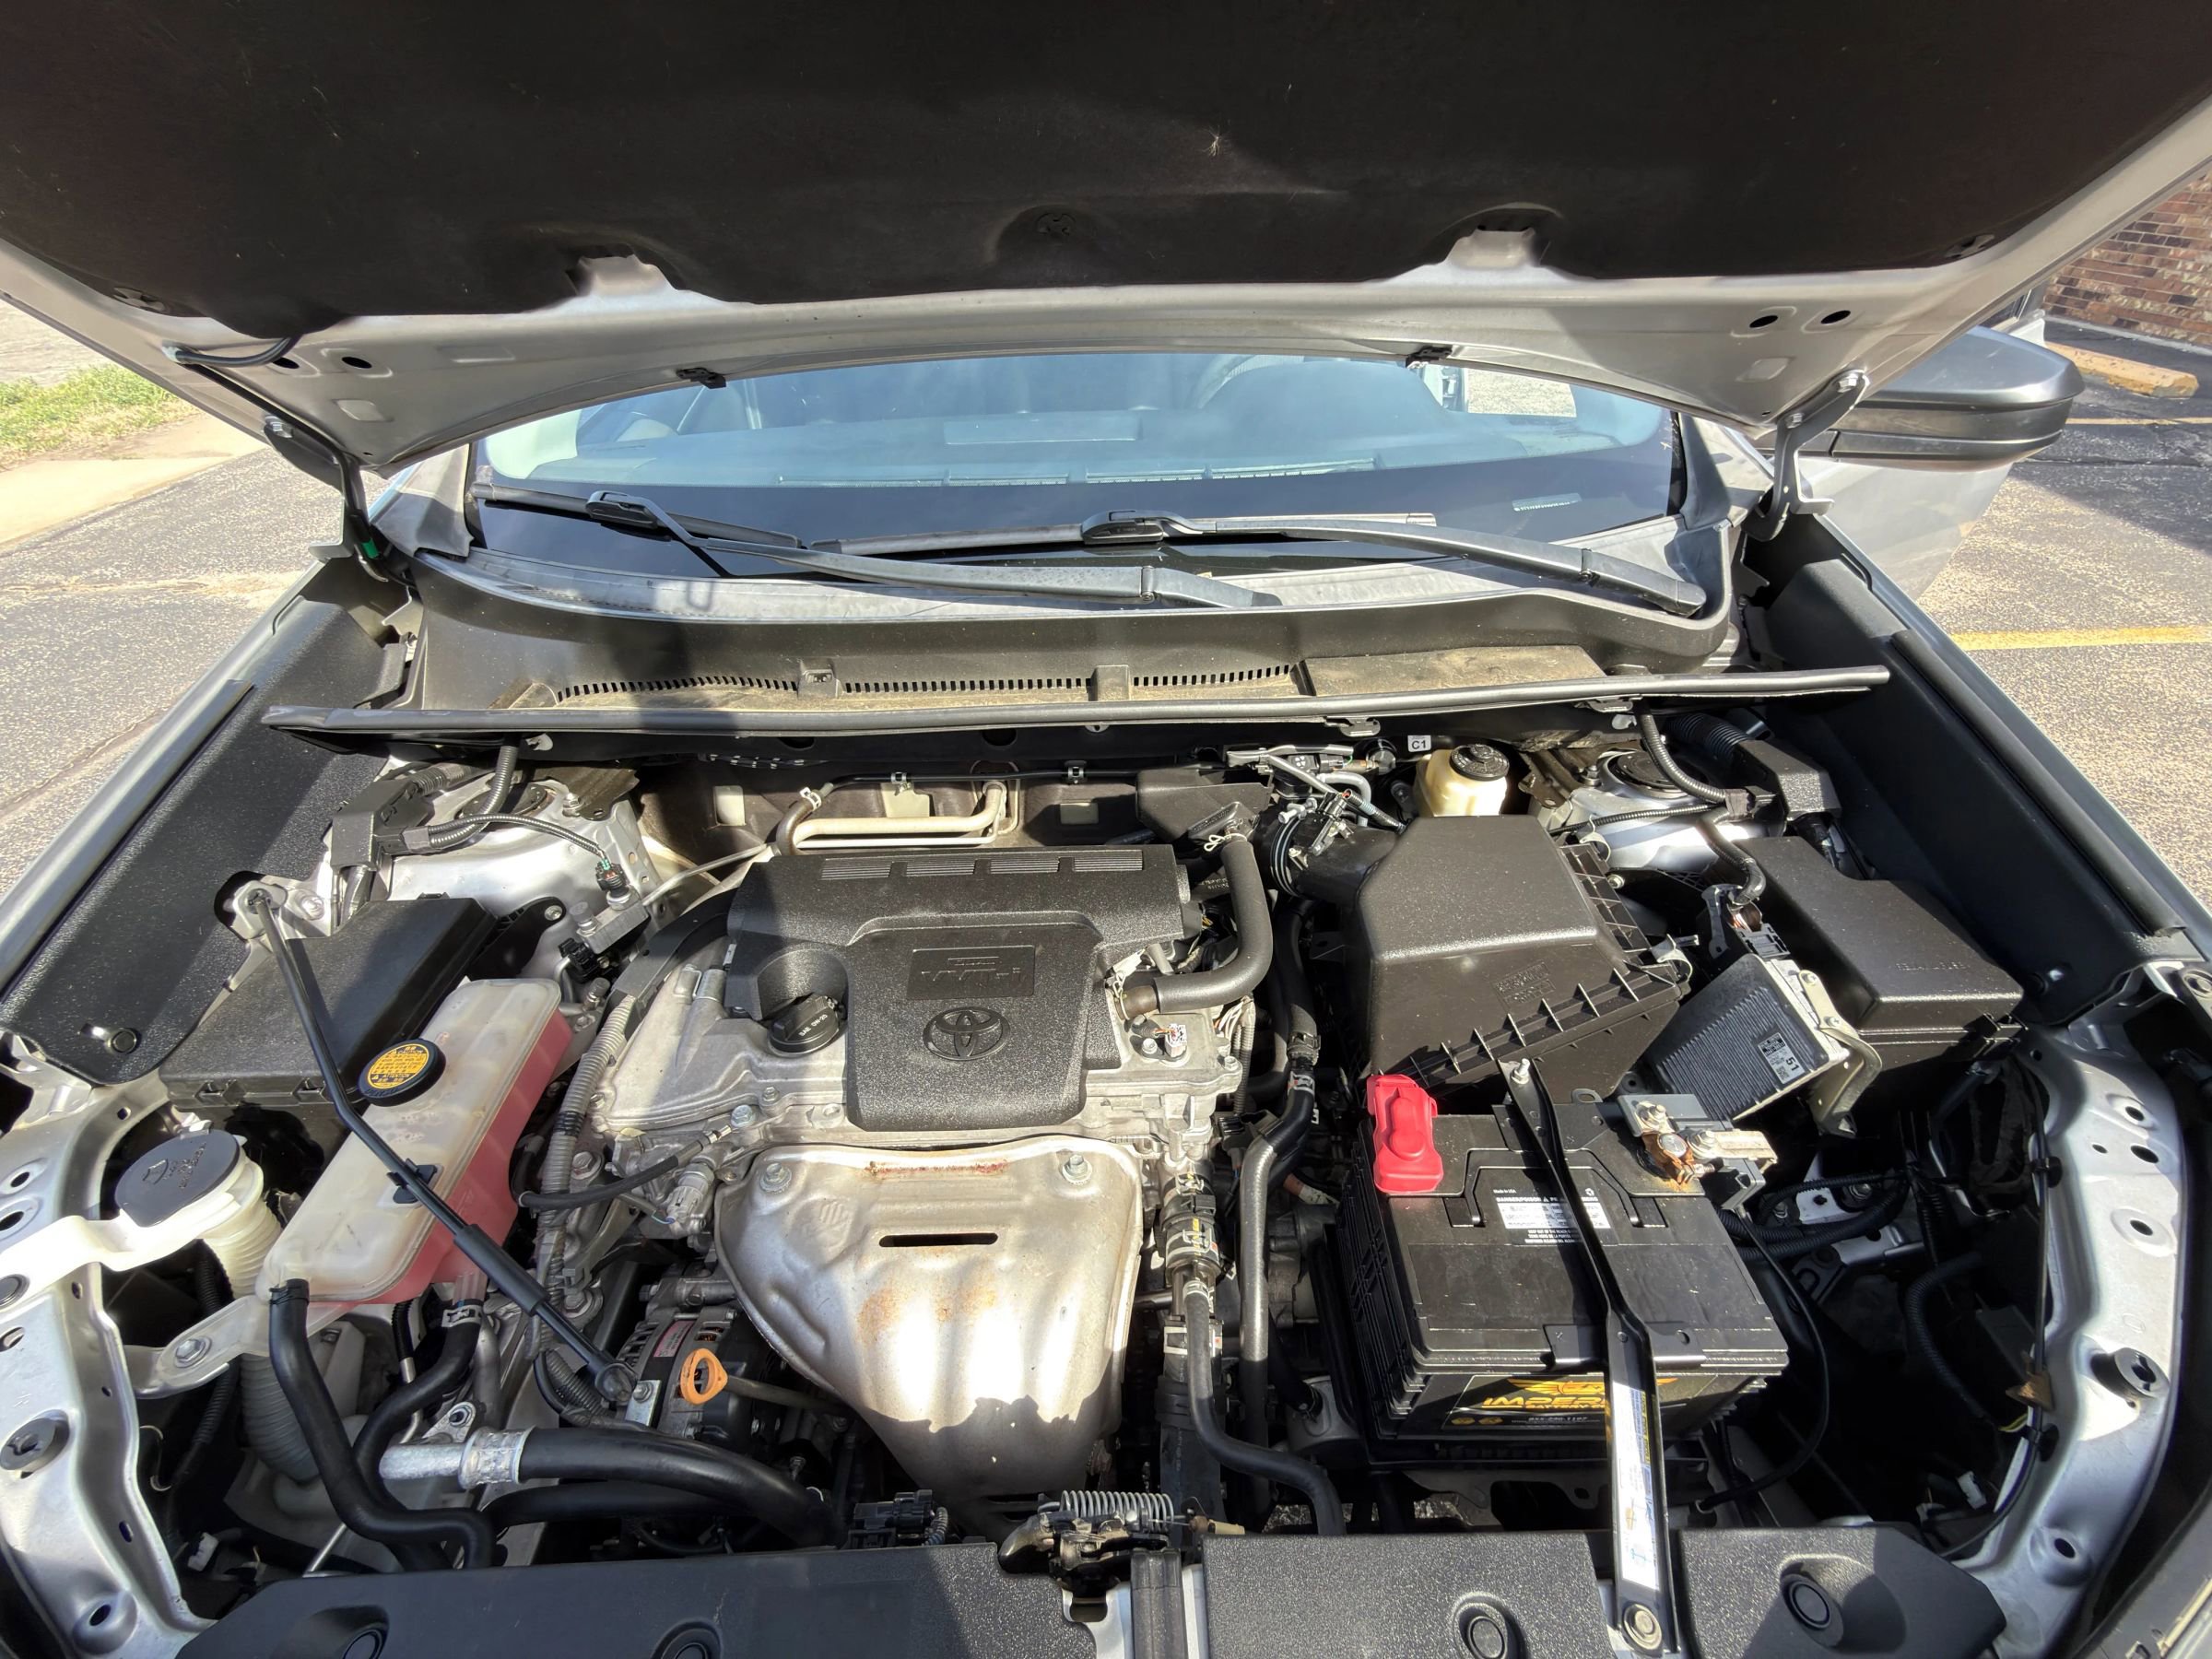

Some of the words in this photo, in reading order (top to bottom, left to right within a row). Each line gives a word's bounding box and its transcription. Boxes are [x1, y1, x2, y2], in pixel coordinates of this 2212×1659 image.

[1412, 740, 1427, 749] C1
[798, 1026, 811, 1036] SAE
[811, 1014, 829, 1027] 0W-20
[1785, 1056, 1800, 1071] 51
